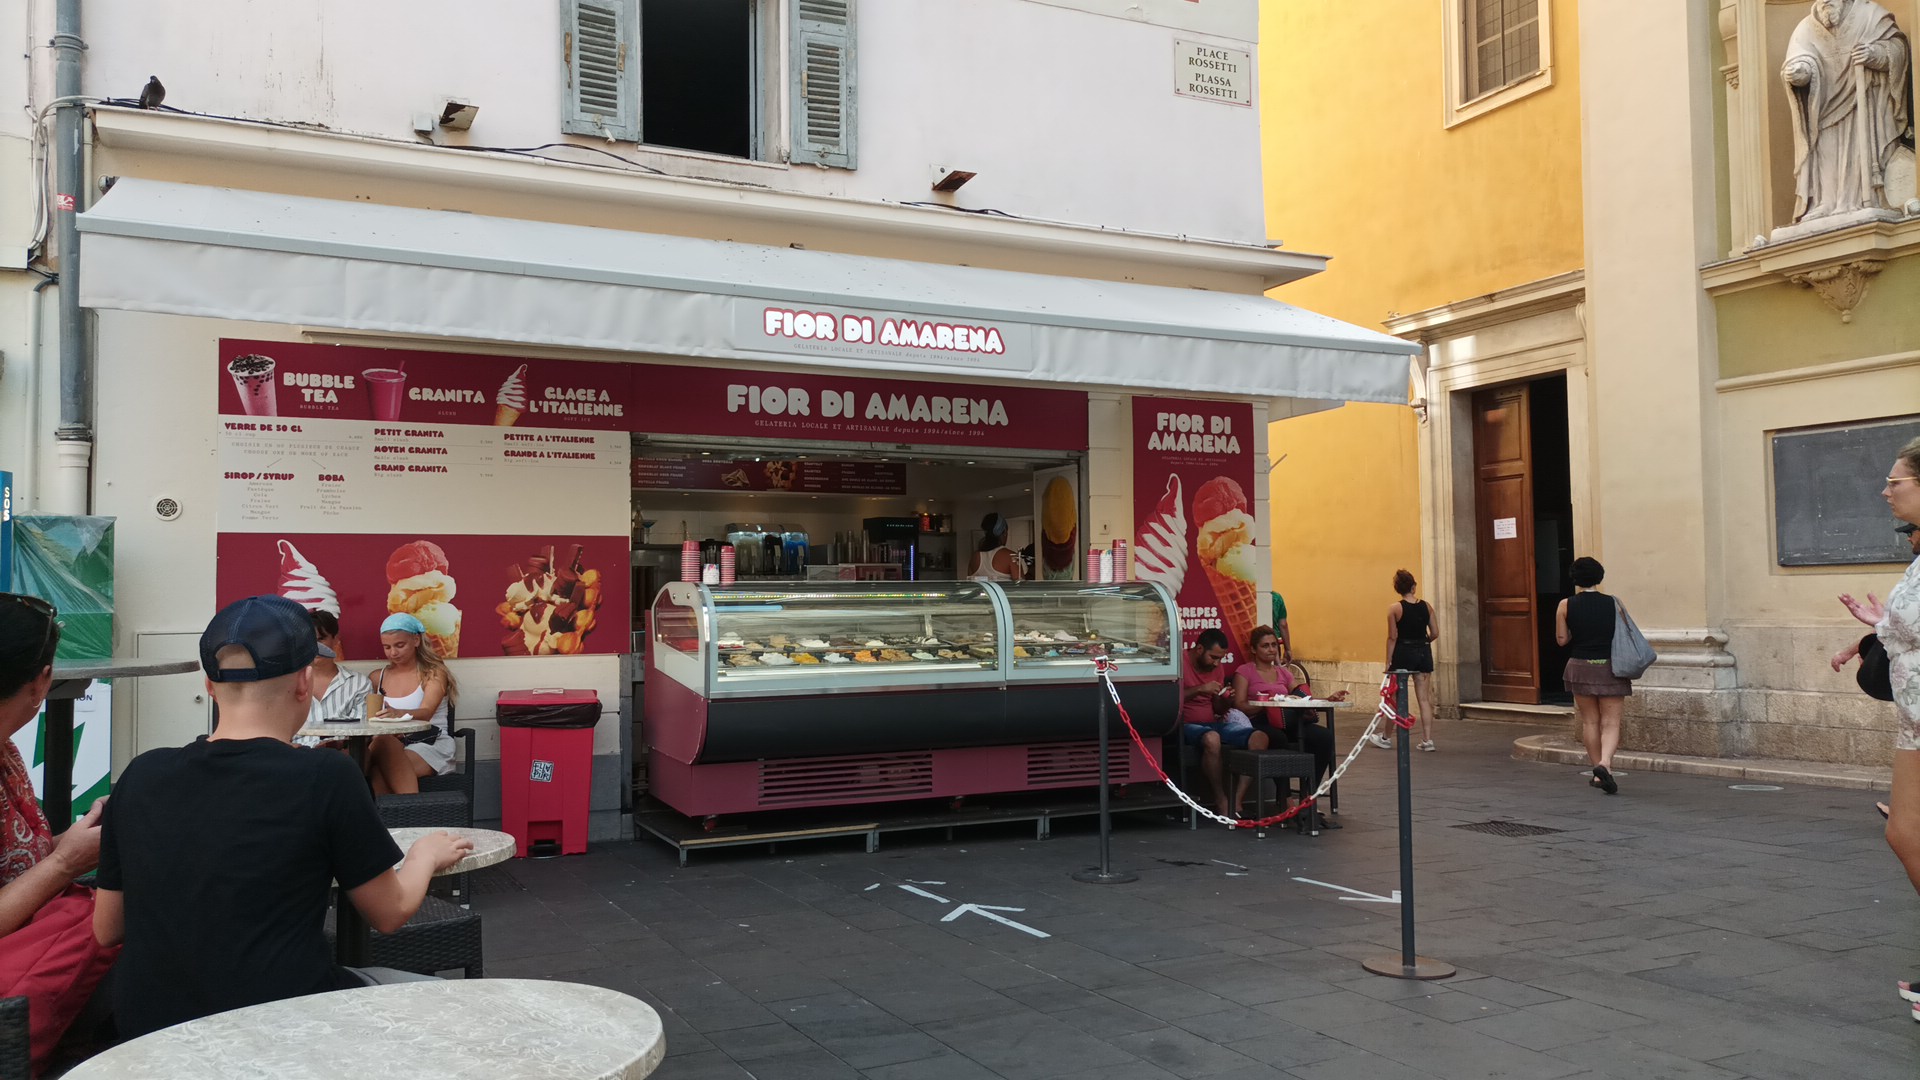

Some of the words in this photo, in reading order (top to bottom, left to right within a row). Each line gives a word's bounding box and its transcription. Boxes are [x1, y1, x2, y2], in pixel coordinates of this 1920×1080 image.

[1197, 47, 1229, 61] PLACE
[1188, 56, 1237, 73] ROSSETTI
[1195, 72, 1232, 87] PLASSA
[1189, 83, 1238, 99] ROSSETTI
[764, 307, 837, 341] FIOR
[842, 315, 874, 344] DI
[878, 319, 1006, 354] AMARENA
[793, 343, 827, 351] GELATERIA
[867, 349, 902, 357] ARTISANALE
[283, 372, 355, 389] BUBBLE
[301, 388, 338, 403] TEA
[408, 387, 486, 404] GRANITA
[544, 387, 596, 401] GLACE
[599, 390, 610, 402] A
[530, 400, 624, 417] L'ITALIENNE
[727, 383, 810, 416] FIOR
[821, 389, 855, 419] DI
[864, 391, 1009, 427] AMARENA
[224, 422, 257, 431] VERRE
[260, 423, 273, 432] DE
[276, 424, 288, 432] 50
[290, 424, 303, 433] CL
[754, 420, 797, 428] GELATERIA
[801, 422, 829, 430] LOCALE
[846, 424, 890, 432] ARTISANALE
[893, 426, 919, 434] depuis
[1156, 412, 1205, 434] FIOR
[1210, 415, 1231, 435] DI
[374, 428, 402, 436] PETIT
[404, 429, 444, 438] GRANITA
[503, 433, 535, 441] PETITE
[545, 435, 595, 444] L'ITALIENNE
[1147, 431, 1240, 455] AMARENA
[374, 446, 406, 454] MOYEN
[408, 446, 448, 455] GRANITA
[503, 450, 538, 458] GRANDE
[547, 451, 596, 460] L'ITALIENNE
[374, 464, 405, 472] GRAND
[408, 465, 448, 473] GRANITA
[224, 472, 255, 480] SIROP
[263, 473, 295, 481] SYRUP
[318, 474, 345, 482] BOBA
[1180, 618, 1222, 630] AUFRES
